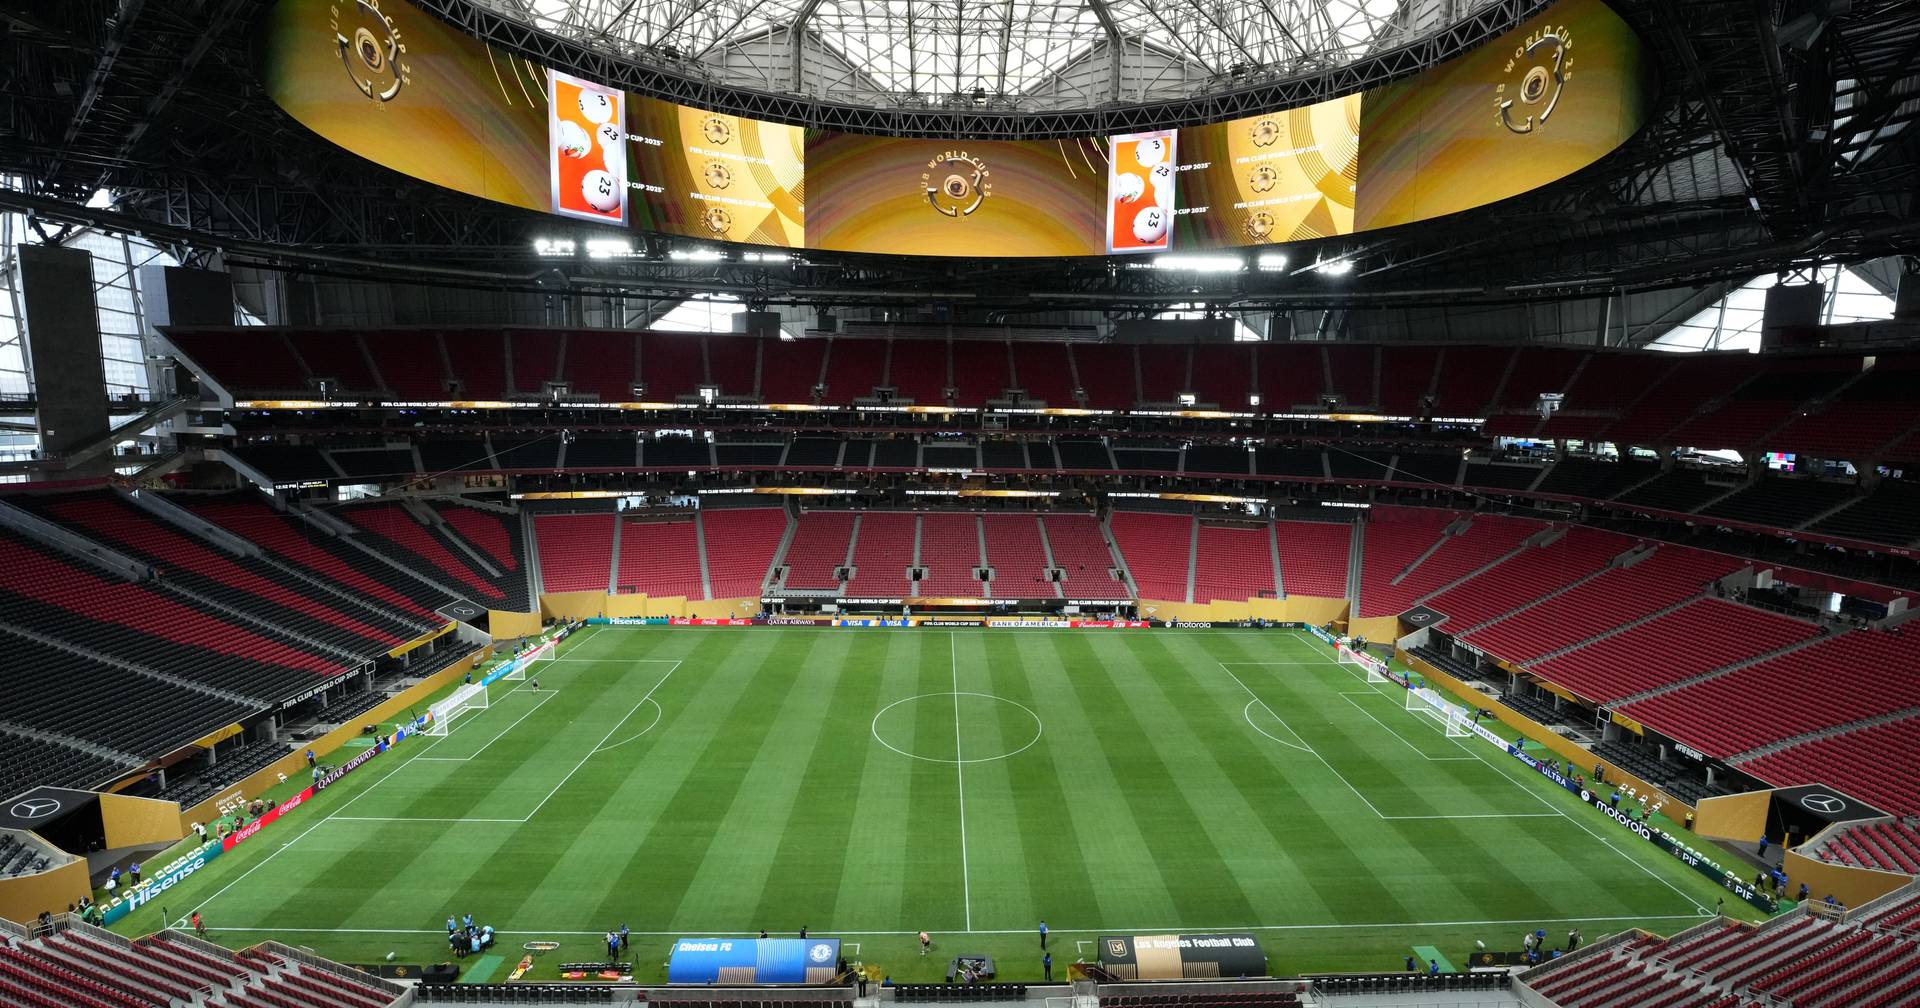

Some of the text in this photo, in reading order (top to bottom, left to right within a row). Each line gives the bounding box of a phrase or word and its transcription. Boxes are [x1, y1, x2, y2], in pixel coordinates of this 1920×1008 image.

[603, 126, 619, 141] 23
[630, 134, 644, 143] CUP
[927, 150, 968, 169] WORLD
[972, 157, 990, 177] CUP
[984, 183, 991, 197] 25
[1156, 165, 1170, 177] 23
[598, 176, 612, 196] 23
[631, 183, 645, 191] CUP
[1148, 212, 1160, 228] 23
[283, 700, 297, 709] FIFA
[298, 691, 313, 702] CLUB
[313, 682, 334, 695] WORLD
[334, 676, 346, 685] CUP
[318, 749, 376, 789] QATAR AIRWAYS
[1542, 765, 1567, 787] ULTRA
[1596, 800, 1651, 841] motorola
[1682, 852, 1699, 867] PIF
[129, 857, 205, 912] Hisense
[1735, 884, 1754, 901] PIF
[679, 942, 733, 951] Chelsea FC
[1134, 937, 1255, 949] Los Angeles Football Club
